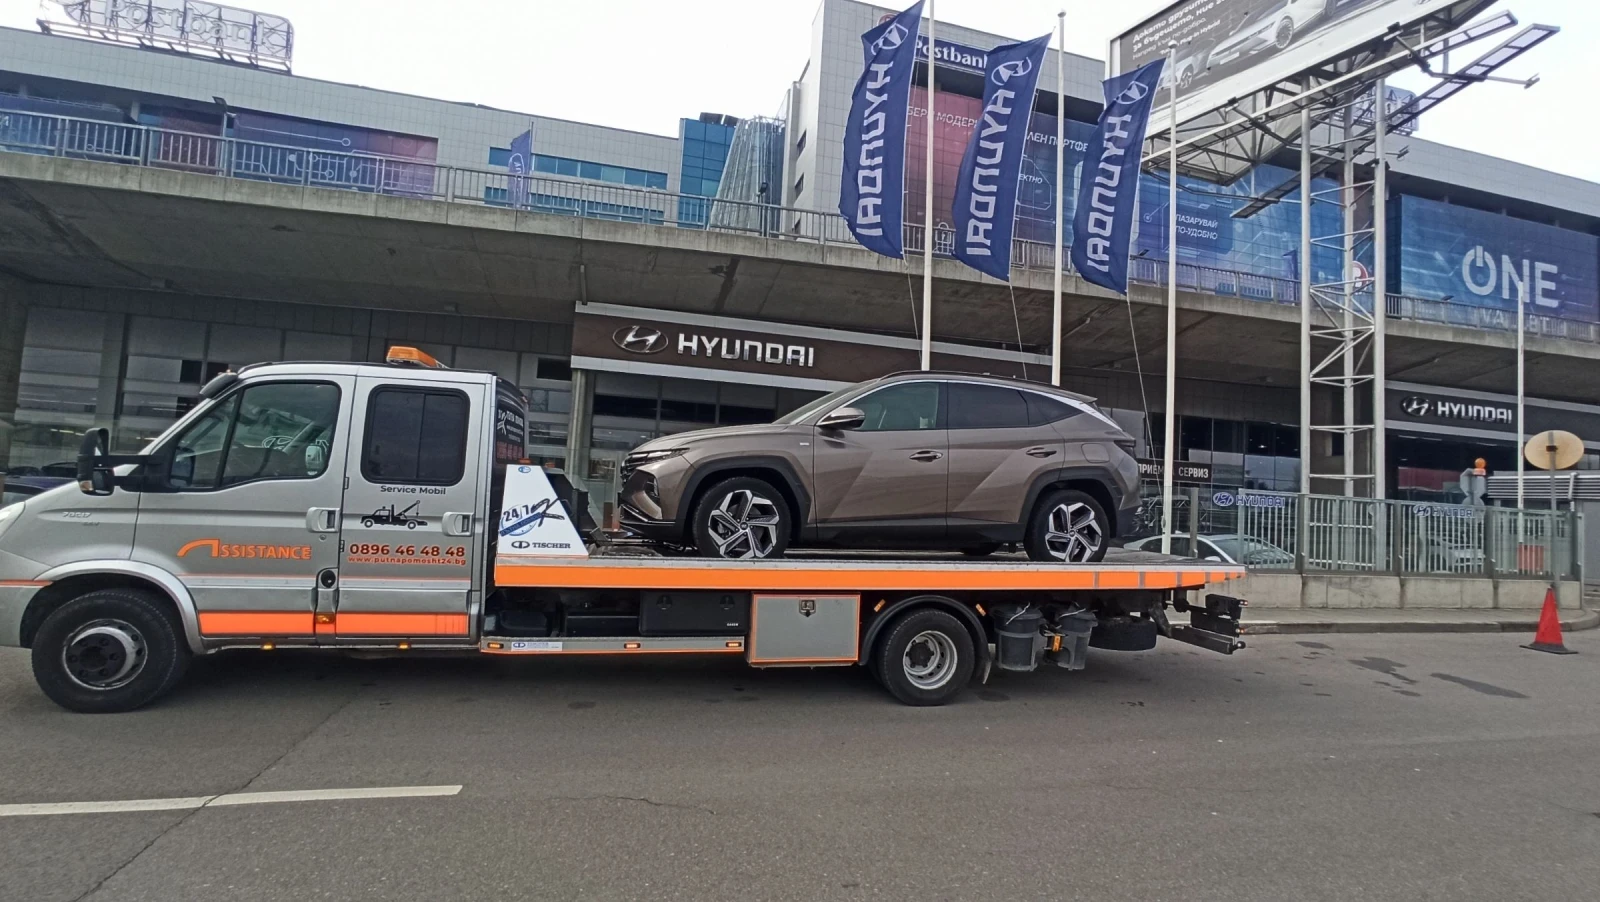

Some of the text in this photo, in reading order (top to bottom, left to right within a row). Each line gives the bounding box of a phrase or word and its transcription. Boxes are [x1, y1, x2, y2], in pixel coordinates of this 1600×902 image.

[104, 0, 278, 49] Postbank
[1176, 225, 1218, 240] ПО-УДОБНО
[1462, 245, 1559, 309] ONE
[677, 332, 815, 368] HYUNDAI
[1437, 400, 1513, 424] HYUNDAI
[1178, 466, 1209, 479] СЕРВИЗ
[380, 484, 447, 495] Service Mobil
[1235, 494, 1286, 509] HYUNDAI
[176, 538, 312, 561] ASSISTANCE
[349, 543, 466, 557] 0896 46 48 48
[348, 557, 466, 566] www.putnapomosht24.bg
